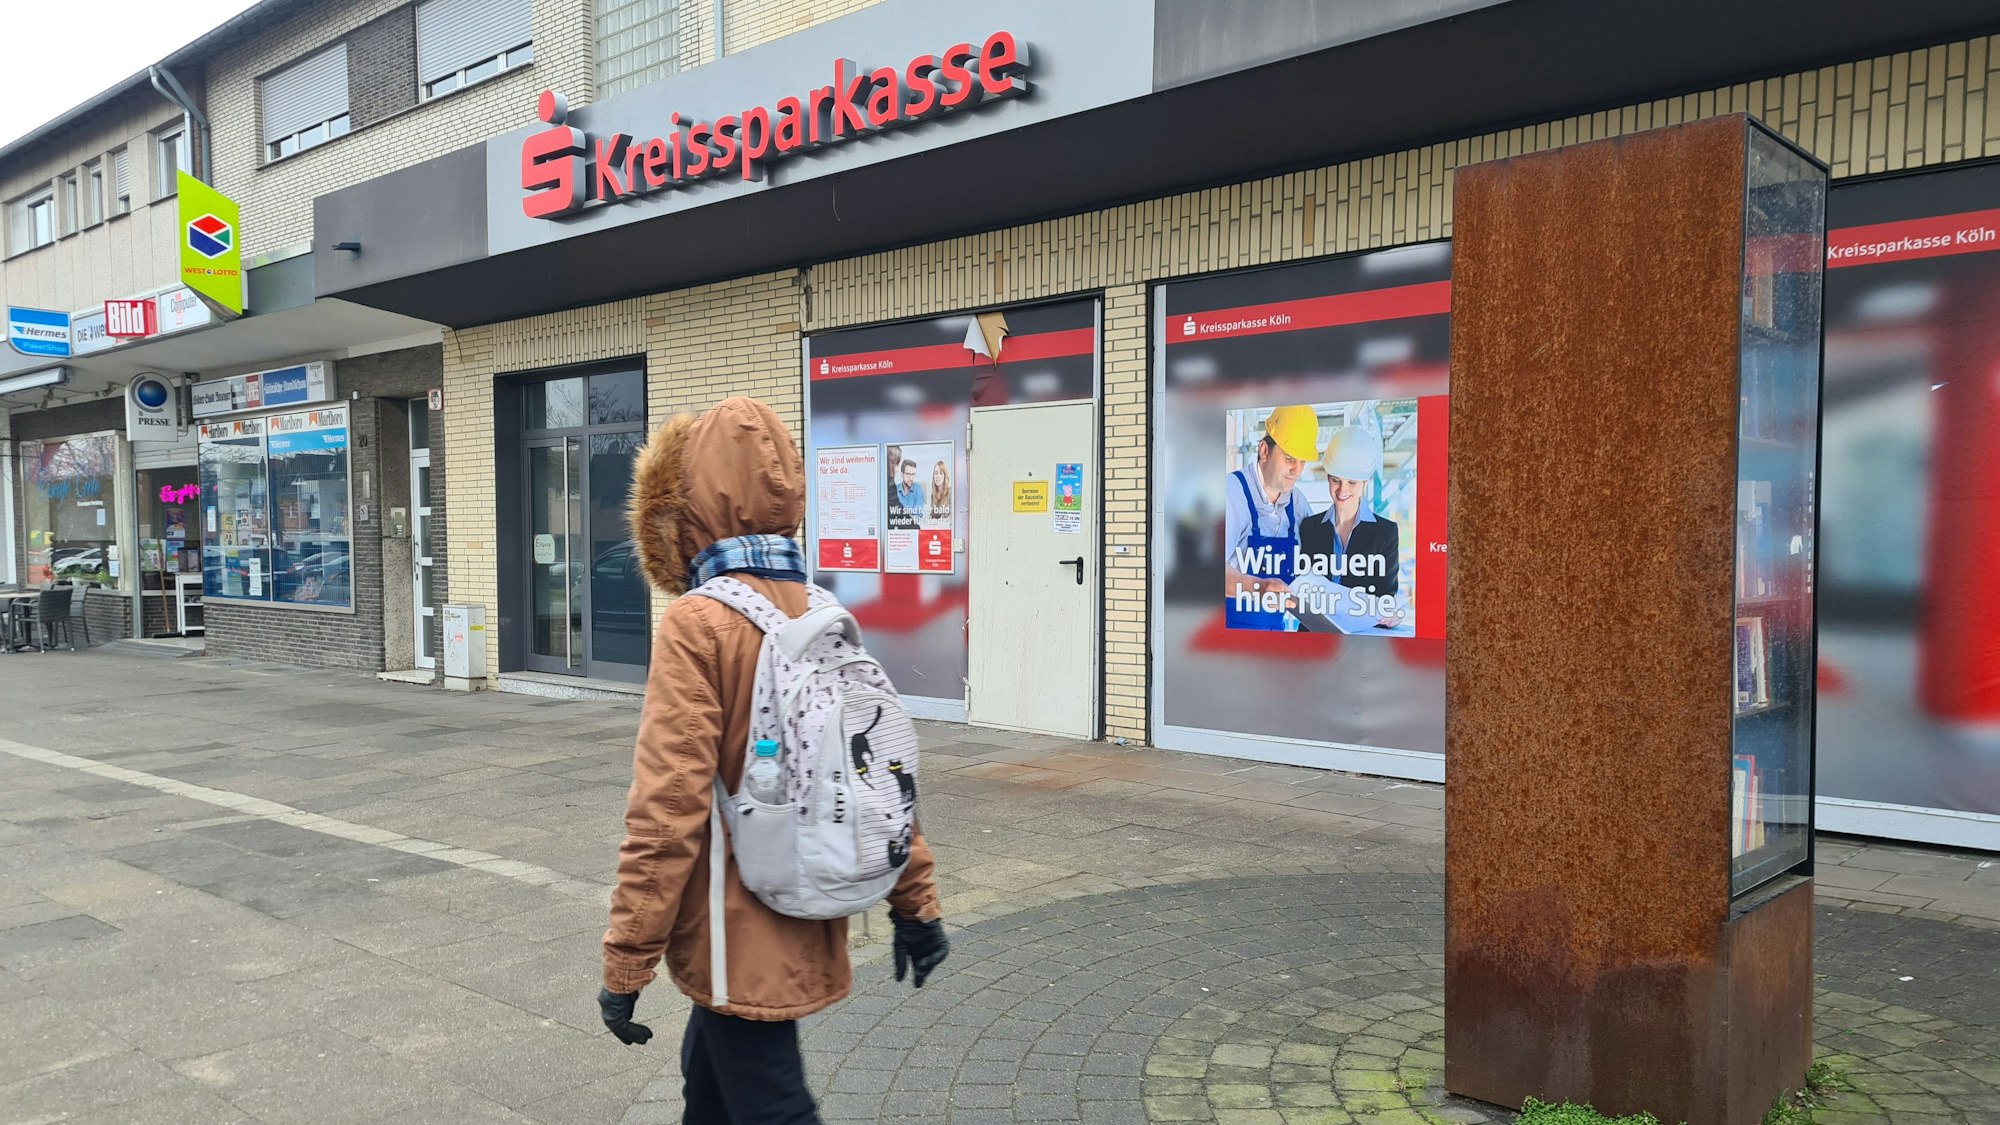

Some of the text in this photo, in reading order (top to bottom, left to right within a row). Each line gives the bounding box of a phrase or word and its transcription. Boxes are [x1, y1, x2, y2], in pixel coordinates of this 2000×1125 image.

[595, 30, 1020, 200] Kreissparkasse
[1827, 226, 1996, 260] Kreissparkasse Köln
[107, 301, 145, 334] Bild
[1199, 313, 1291, 334] Kreissparkasse Köln
[25, 327, 67, 339] Hermes
[77, 328, 88, 343] DIE
[23, 342, 67, 352] PaketShop
[831, 359, 893, 375] Kreissparkasse Köln
[138, 417, 171, 426] PRESSE
[208, 411, 343, 439] Marlboro Marlboro Marlboro Marlboro
[326, 434, 345, 443] Hermes
[819, 454, 875, 465] Wir sind weiterhin
[819, 466, 829, 475] für
[829, 466, 839, 475] Sie
[889, 505, 902, 515] Wir
[903, 505, 917, 515] sind
[934, 504, 950, 514] bald
[889, 516, 912, 526] wieder
[913, 516, 924, 525] für
[1430, 541, 1448, 553] Kre
[1236, 546, 1387, 577] Wir bauen
[1235, 582, 1406, 618] hier für Sie.
